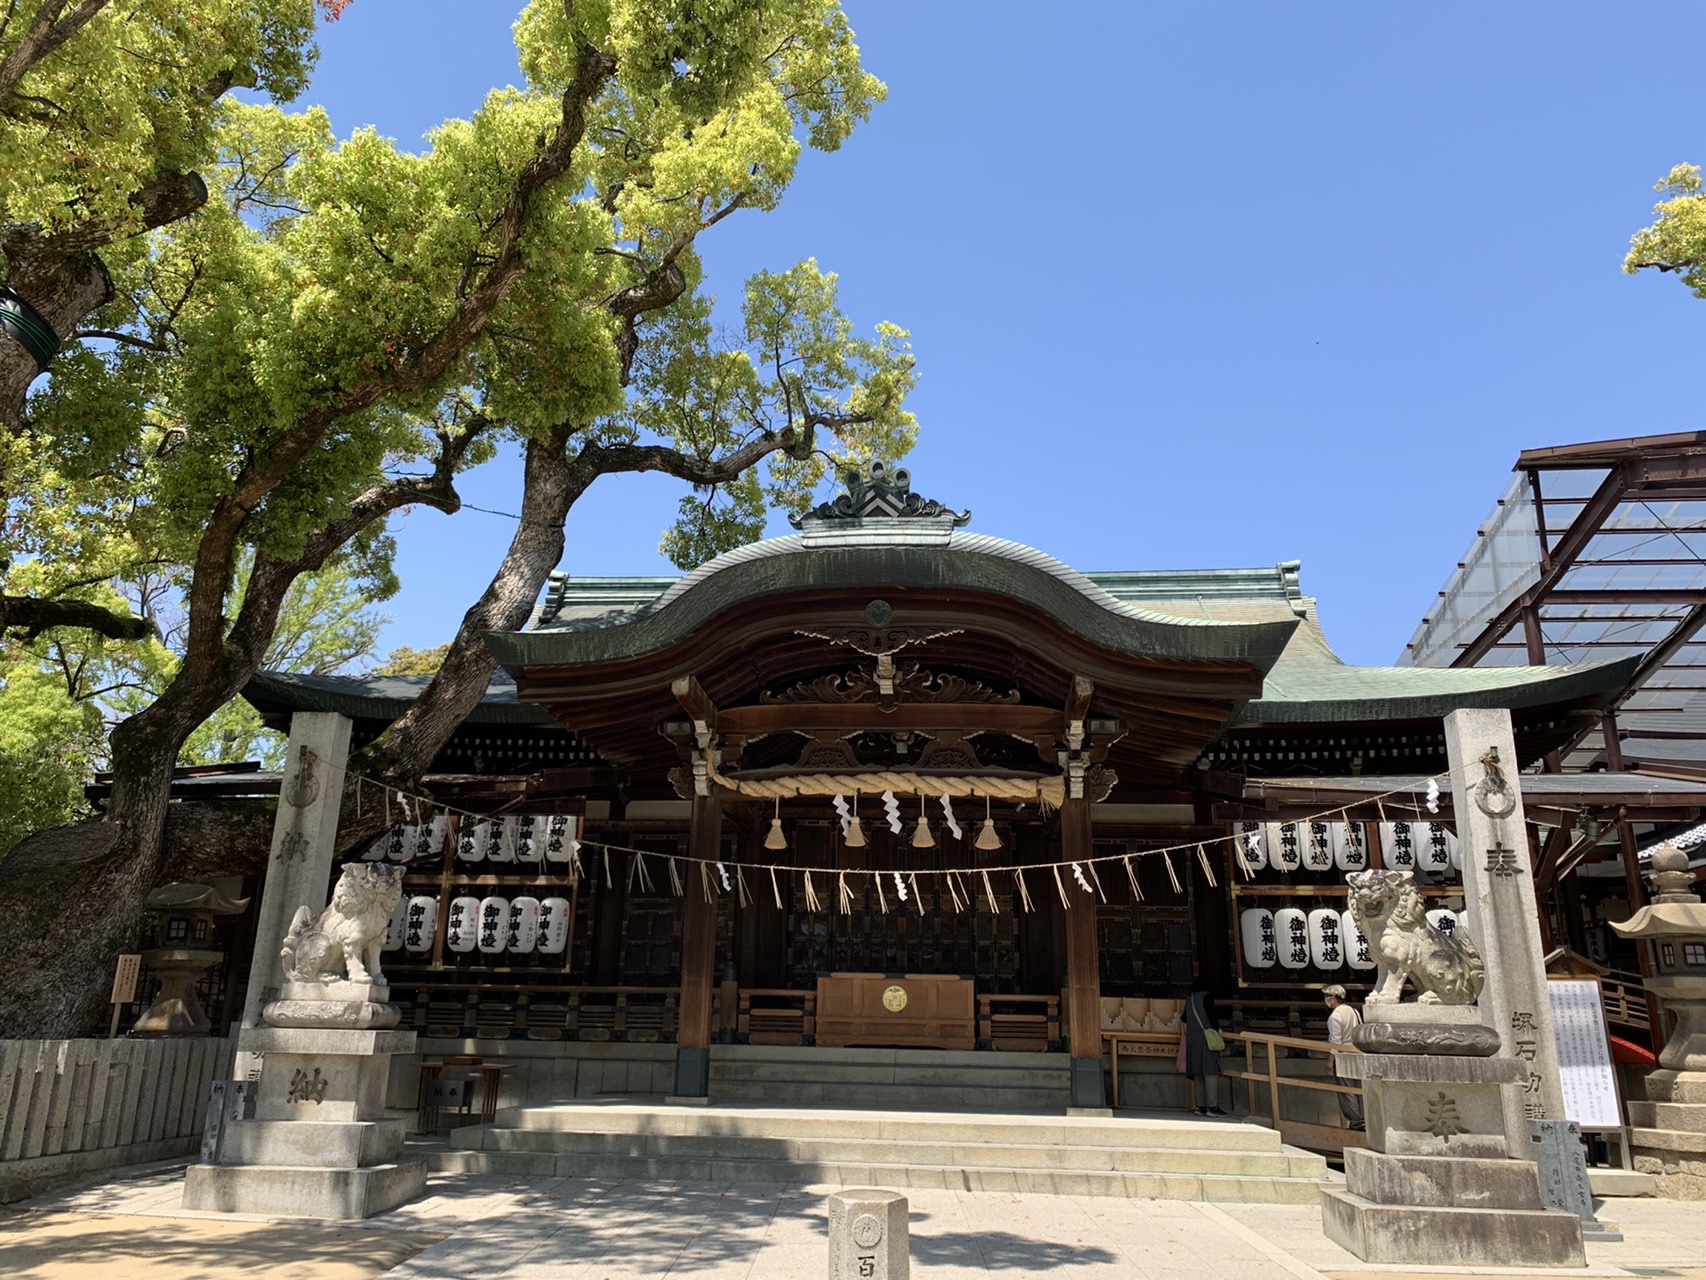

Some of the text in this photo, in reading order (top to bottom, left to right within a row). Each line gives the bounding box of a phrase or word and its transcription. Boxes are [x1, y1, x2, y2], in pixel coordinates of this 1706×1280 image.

[548, 816, 568, 853] 御神燈
[1393, 822, 1413, 866] 御神燈
[1428, 822, 1448, 865] 御神燈
[1483, 841, 1524, 881] 奉
[407, 903, 425, 947] 御神燈
[449, 902, 464, 947] 御神燈
[481, 904, 500, 949] 御神燈
[507, 904, 523, 949] 御神燈
[538, 903, 553, 947] 御神燈
[1260, 915, 1275, 962] 御神燈
[1289, 916, 1308, 964] 御神燈
[1320, 915, 1340, 963] 御神燈
[286, 1067, 329, 1105] 納
[1422, 1091, 1471, 1144] 奉
[857, 1255, 876, 1278] 百
